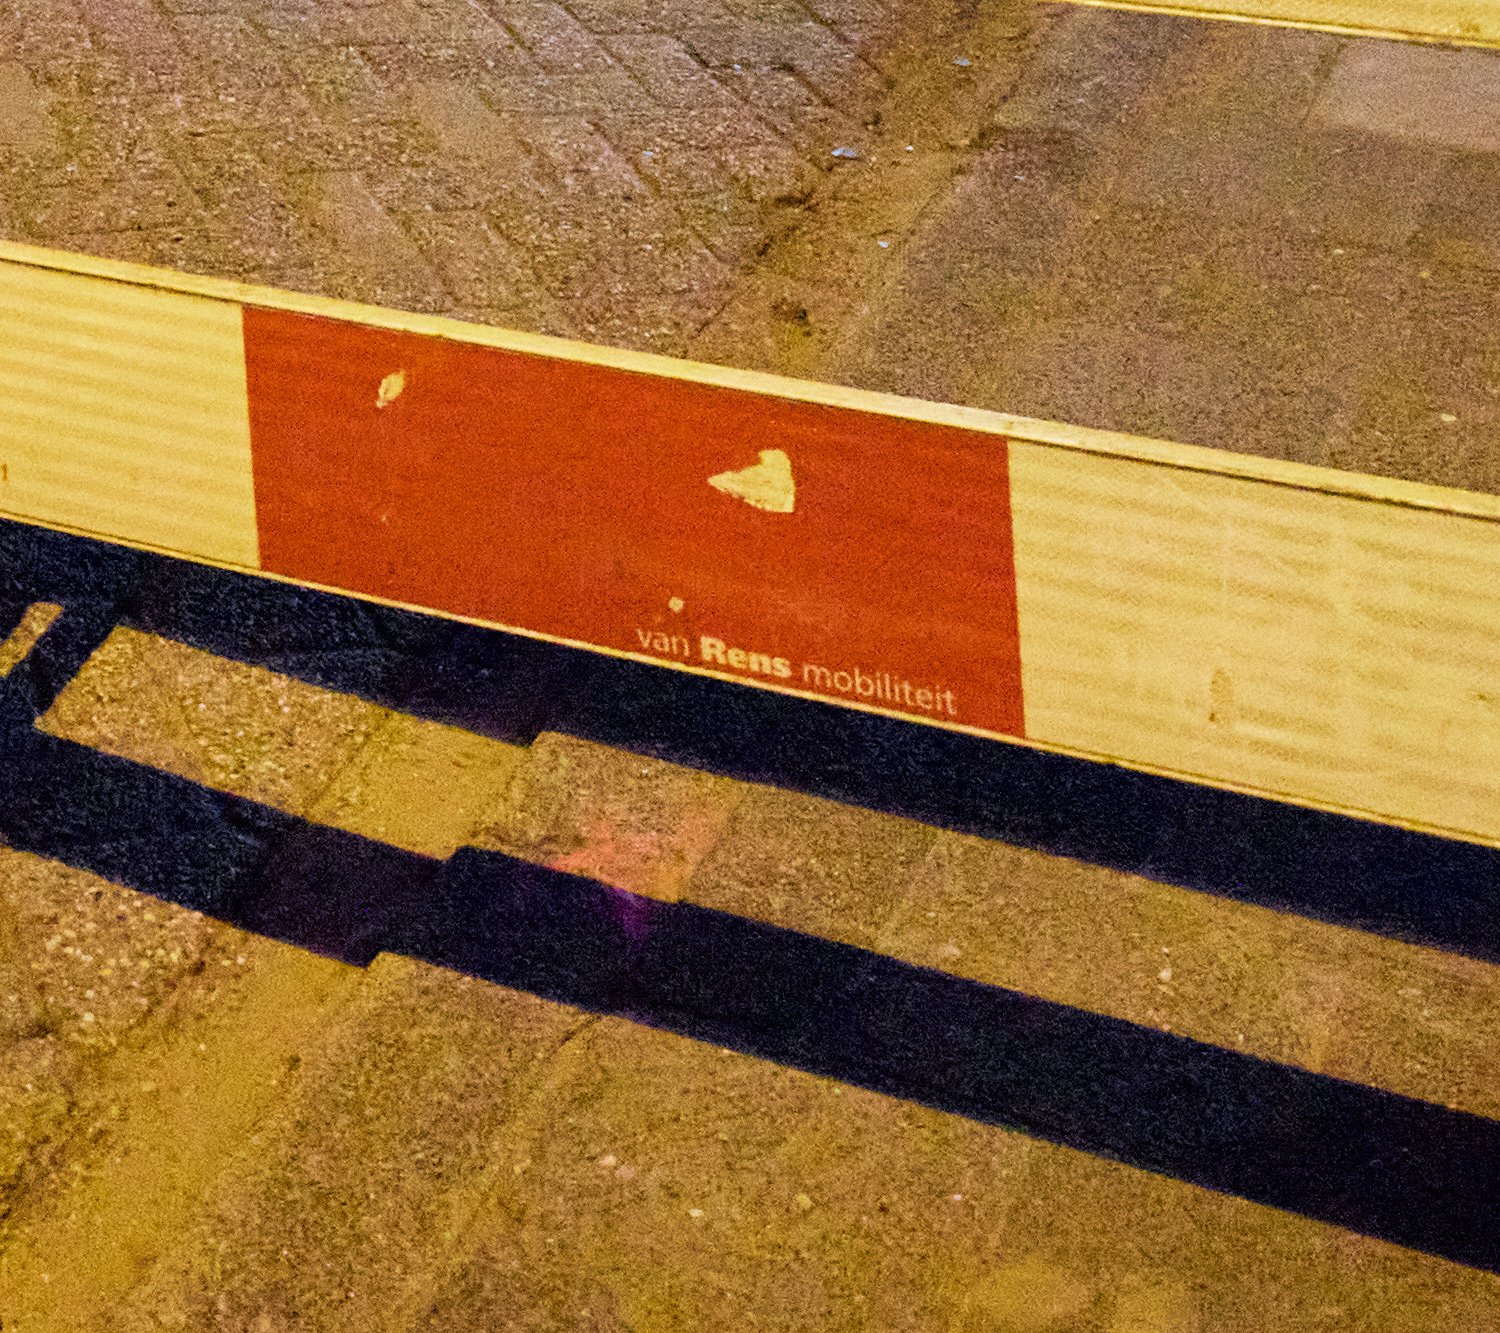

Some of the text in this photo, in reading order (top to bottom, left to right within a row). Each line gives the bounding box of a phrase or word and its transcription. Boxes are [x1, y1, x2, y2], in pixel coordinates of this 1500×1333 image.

[637, 628, 958, 715] van Rens mobiliteit
